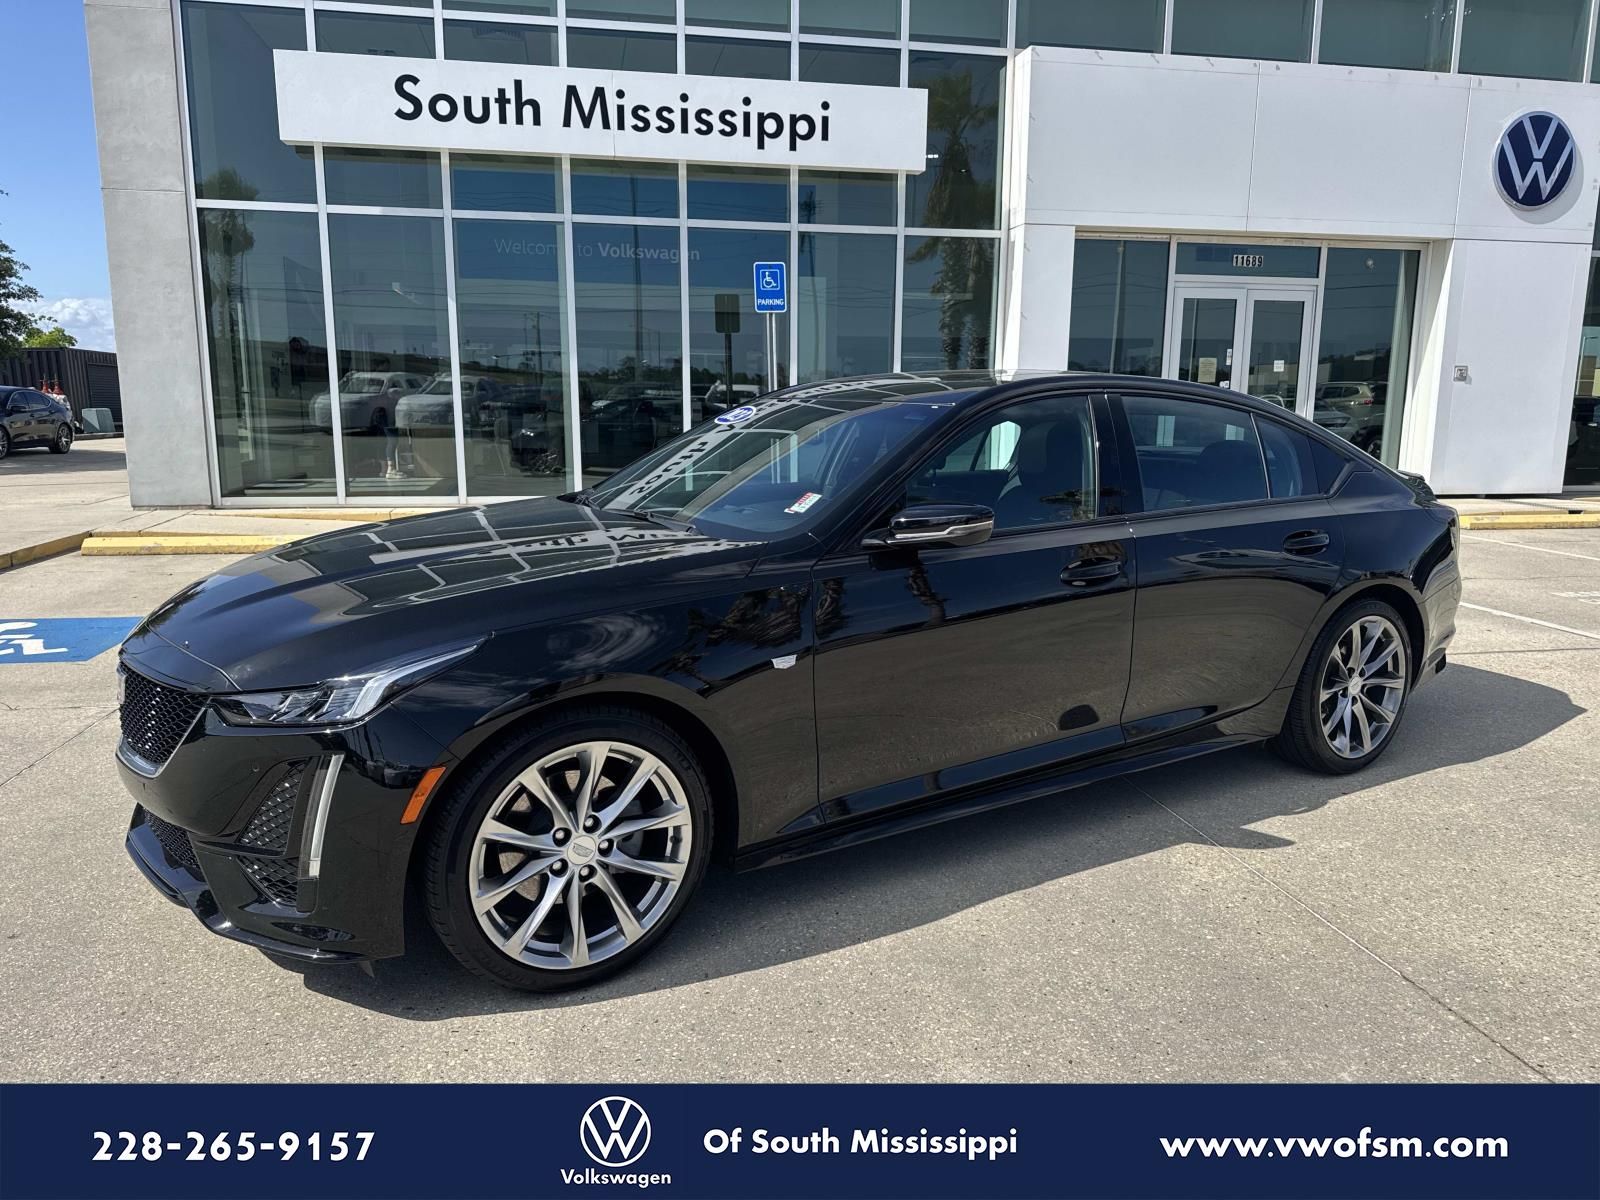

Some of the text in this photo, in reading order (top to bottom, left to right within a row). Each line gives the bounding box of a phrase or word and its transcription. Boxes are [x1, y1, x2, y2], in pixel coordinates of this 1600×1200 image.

[394, 74, 830, 151] South Mississippi
[1494, 111, 1576, 211] VW
[494, 239, 700, 263] Welcom to Volkswagn
[1234, 255, 1263, 267] 11689
[757, 298, 785, 306] PARKING
